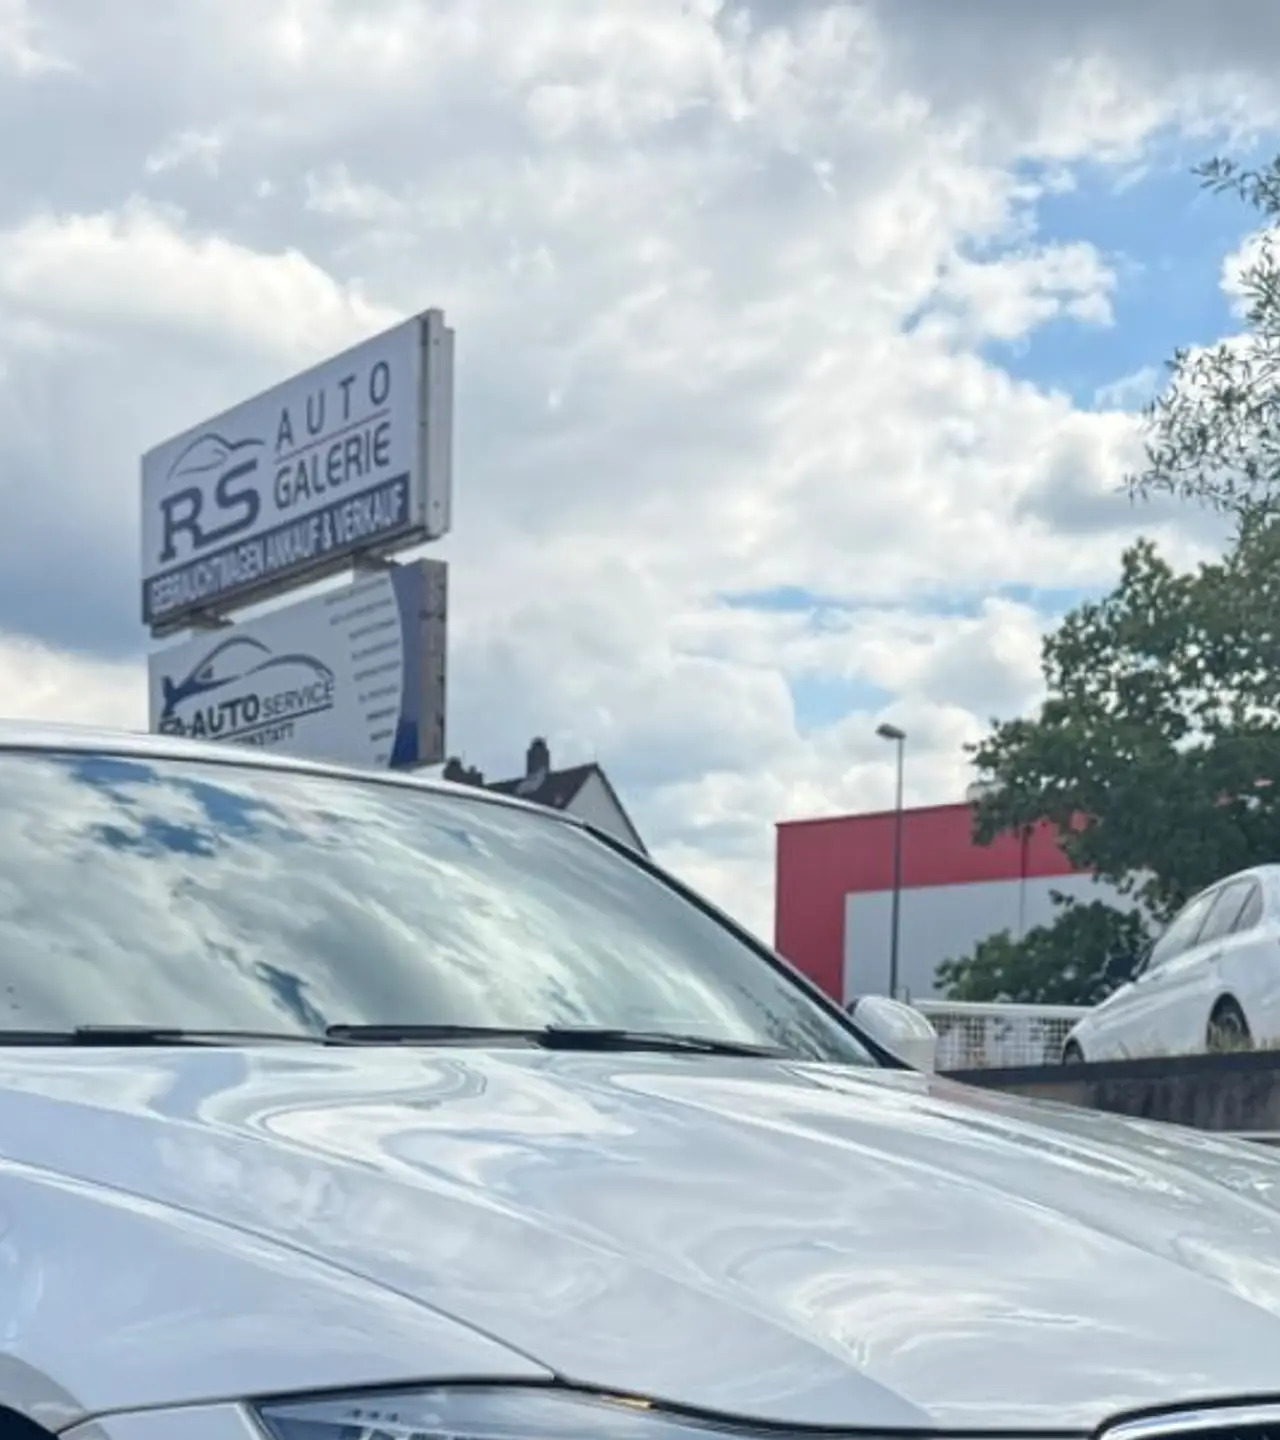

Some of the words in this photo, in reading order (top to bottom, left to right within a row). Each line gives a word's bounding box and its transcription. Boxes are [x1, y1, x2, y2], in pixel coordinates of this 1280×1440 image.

[275, 359, 391, 452] AUTO
[158, 457, 261, 562] RS
[273, 421, 391, 510] GALERIE
[262, 681, 335, 718] SERVICE
